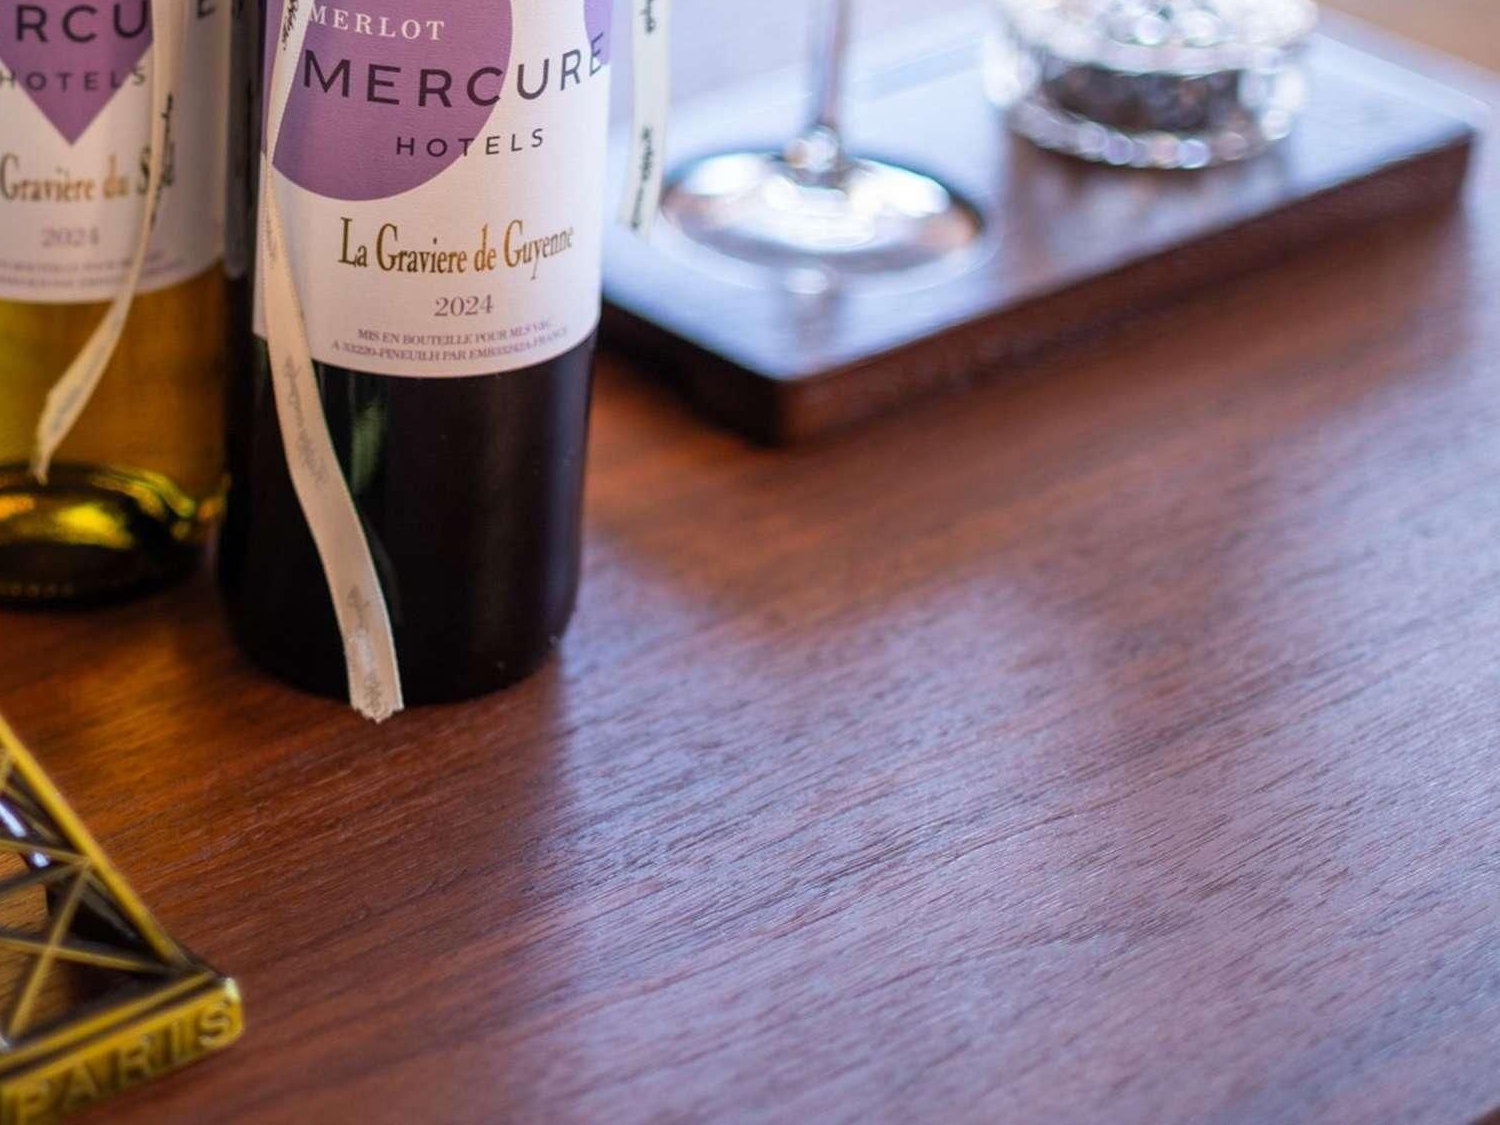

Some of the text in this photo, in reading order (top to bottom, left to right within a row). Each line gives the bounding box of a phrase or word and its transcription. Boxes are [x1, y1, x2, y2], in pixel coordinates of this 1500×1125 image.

[307, 4, 445, 42] MERLOT
[302, 32, 604, 108] MERCURE
[396, 127, 544, 158] HOTELS
[102, 152, 130, 200] du
[337, 216, 368, 268] La
[473, 223, 498, 273] de
[503, 219, 575, 281] Guyenne
[434, 293, 494, 317] 2024
[357, 328, 380, 341] MIS
[382, 331, 400, 344] EN
[402, 333, 473, 346] BOUTEILLE
